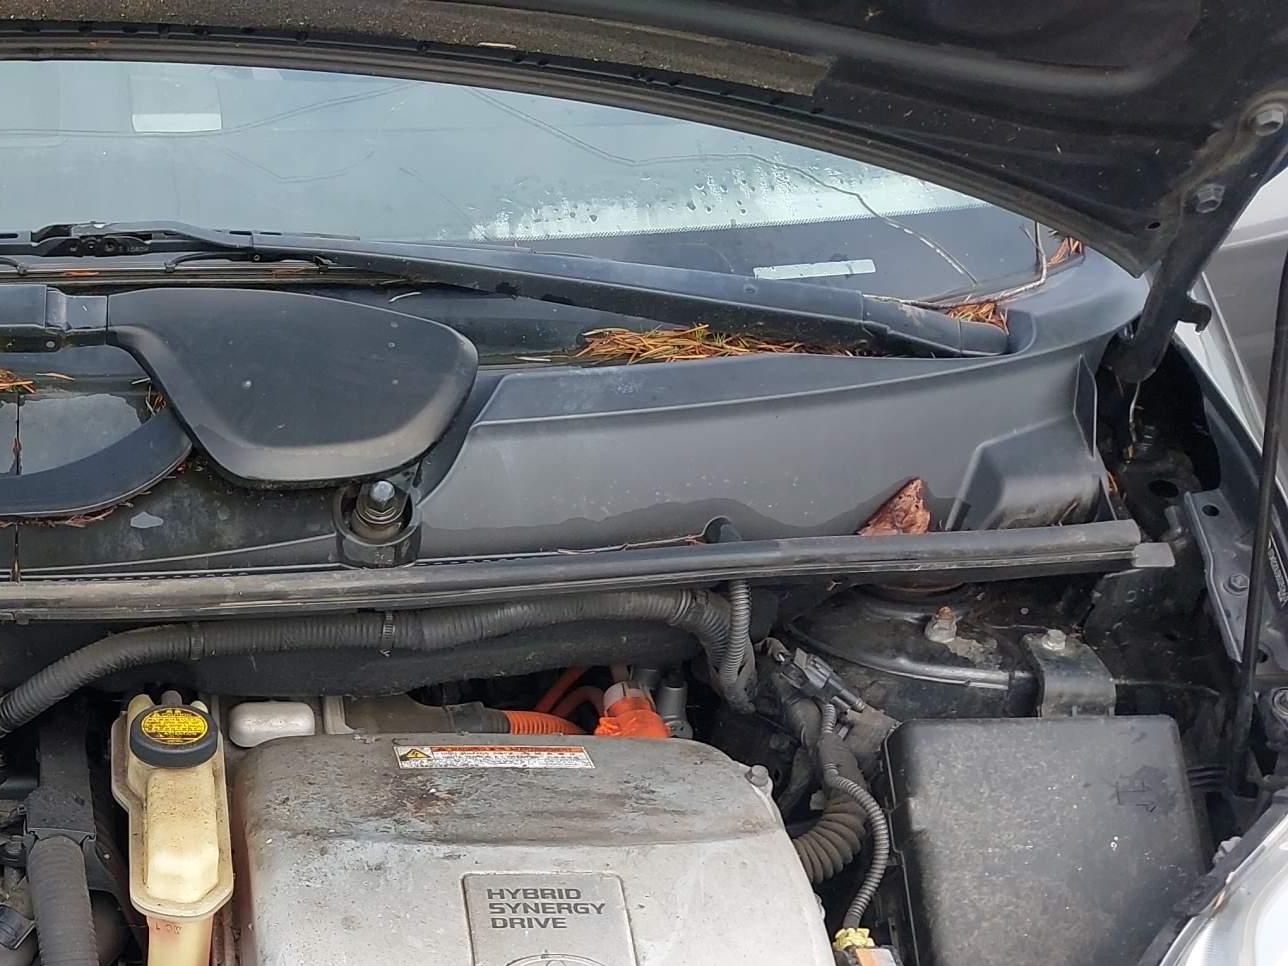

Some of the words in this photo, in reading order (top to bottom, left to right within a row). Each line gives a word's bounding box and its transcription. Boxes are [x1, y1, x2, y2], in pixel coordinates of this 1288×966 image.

[486, 888, 582, 900] HYBRID
[489, 902, 606, 915] SYNERGY
[491, 917, 568, 929] DRIVE
